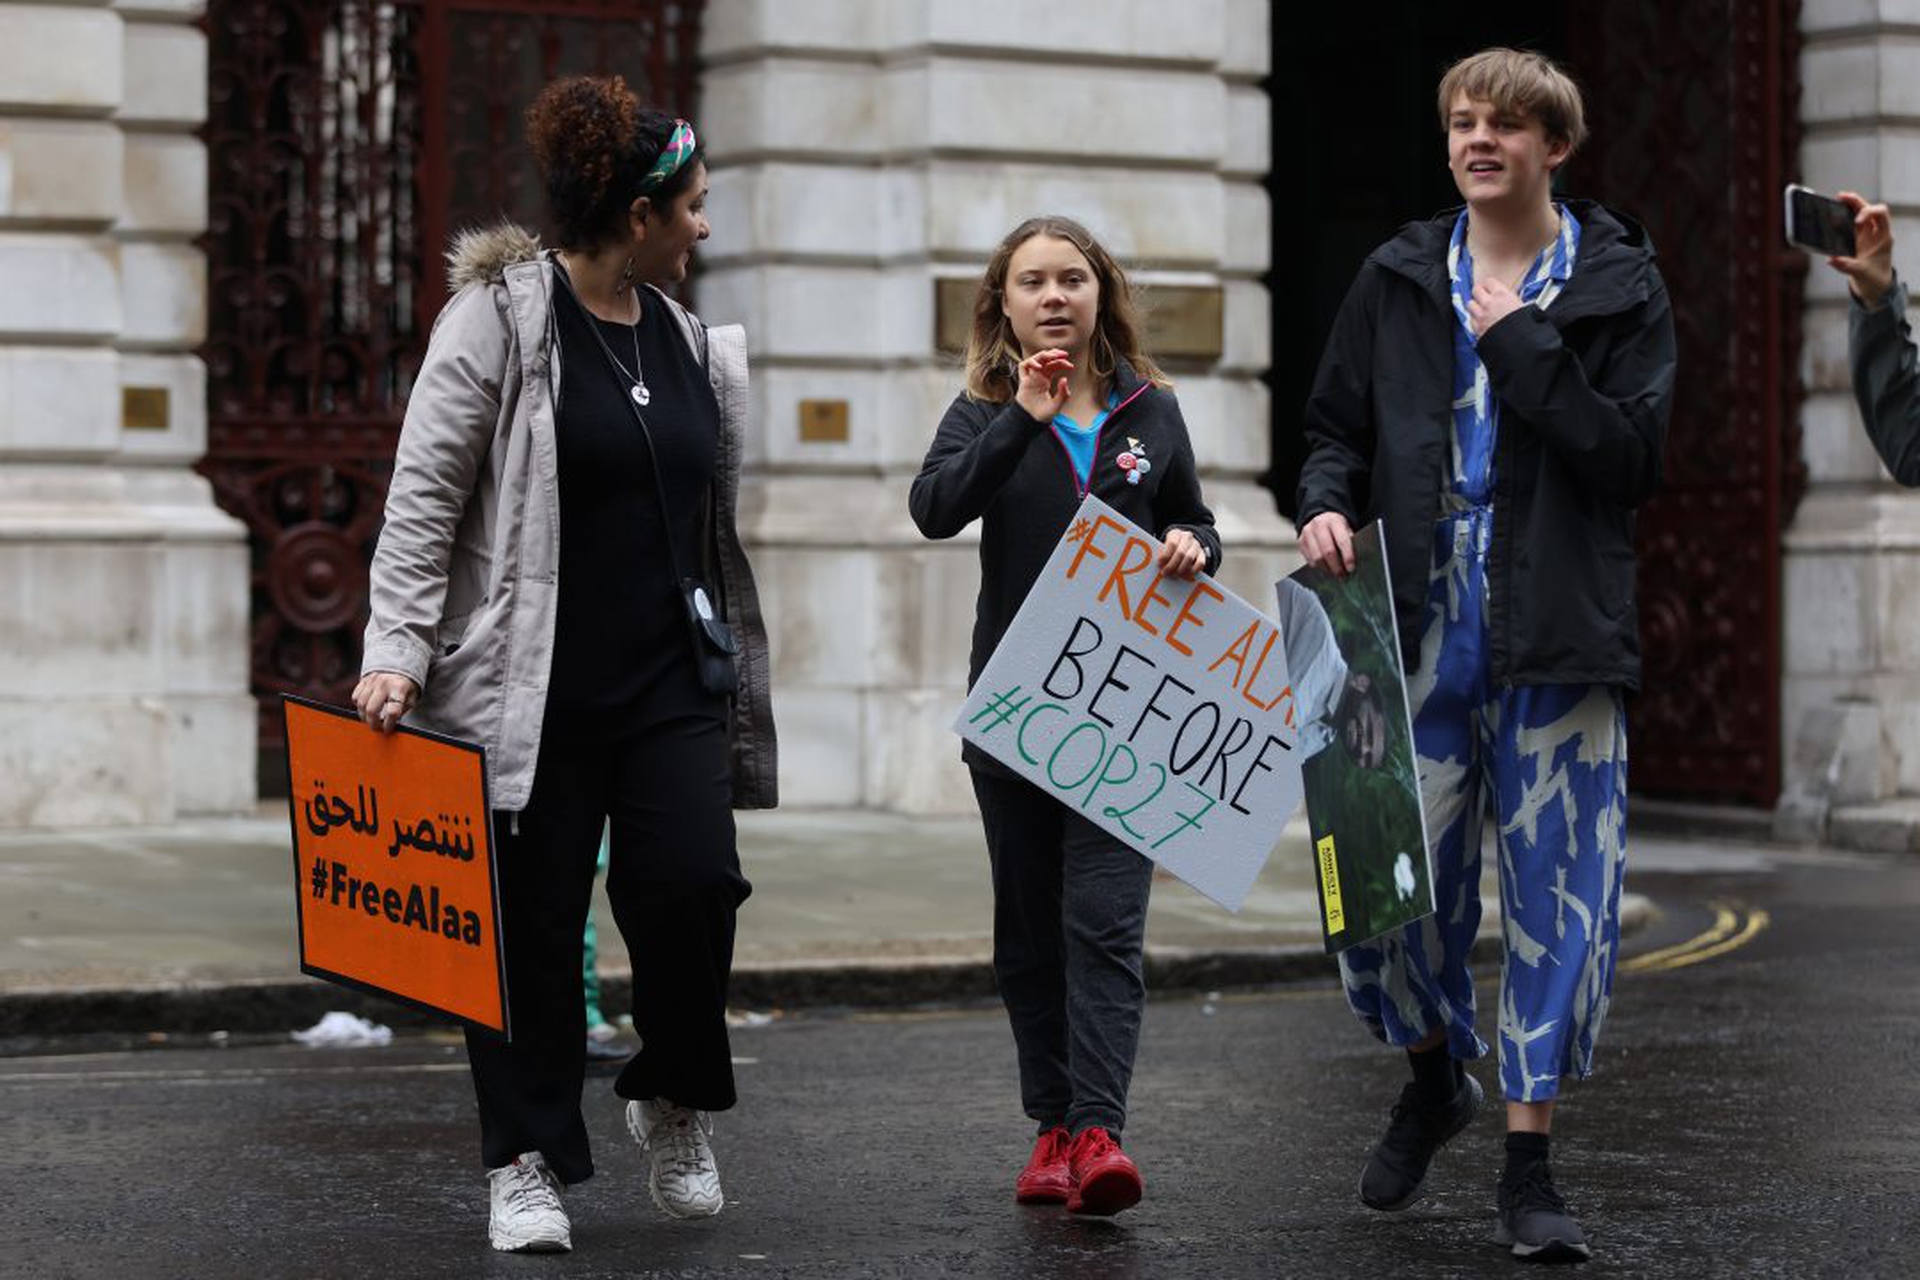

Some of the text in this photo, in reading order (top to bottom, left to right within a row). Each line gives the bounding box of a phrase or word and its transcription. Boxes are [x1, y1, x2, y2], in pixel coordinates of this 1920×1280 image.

[1066, 514, 1297, 729] #FREE ALA
[969, 686, 1217, 849] #COP27
[1042, 616, 1291, 815] BEFORE
[305, 779, 474, 861] ننتصر للحق
[312, 857, 481, 946] #FreeAlaa
